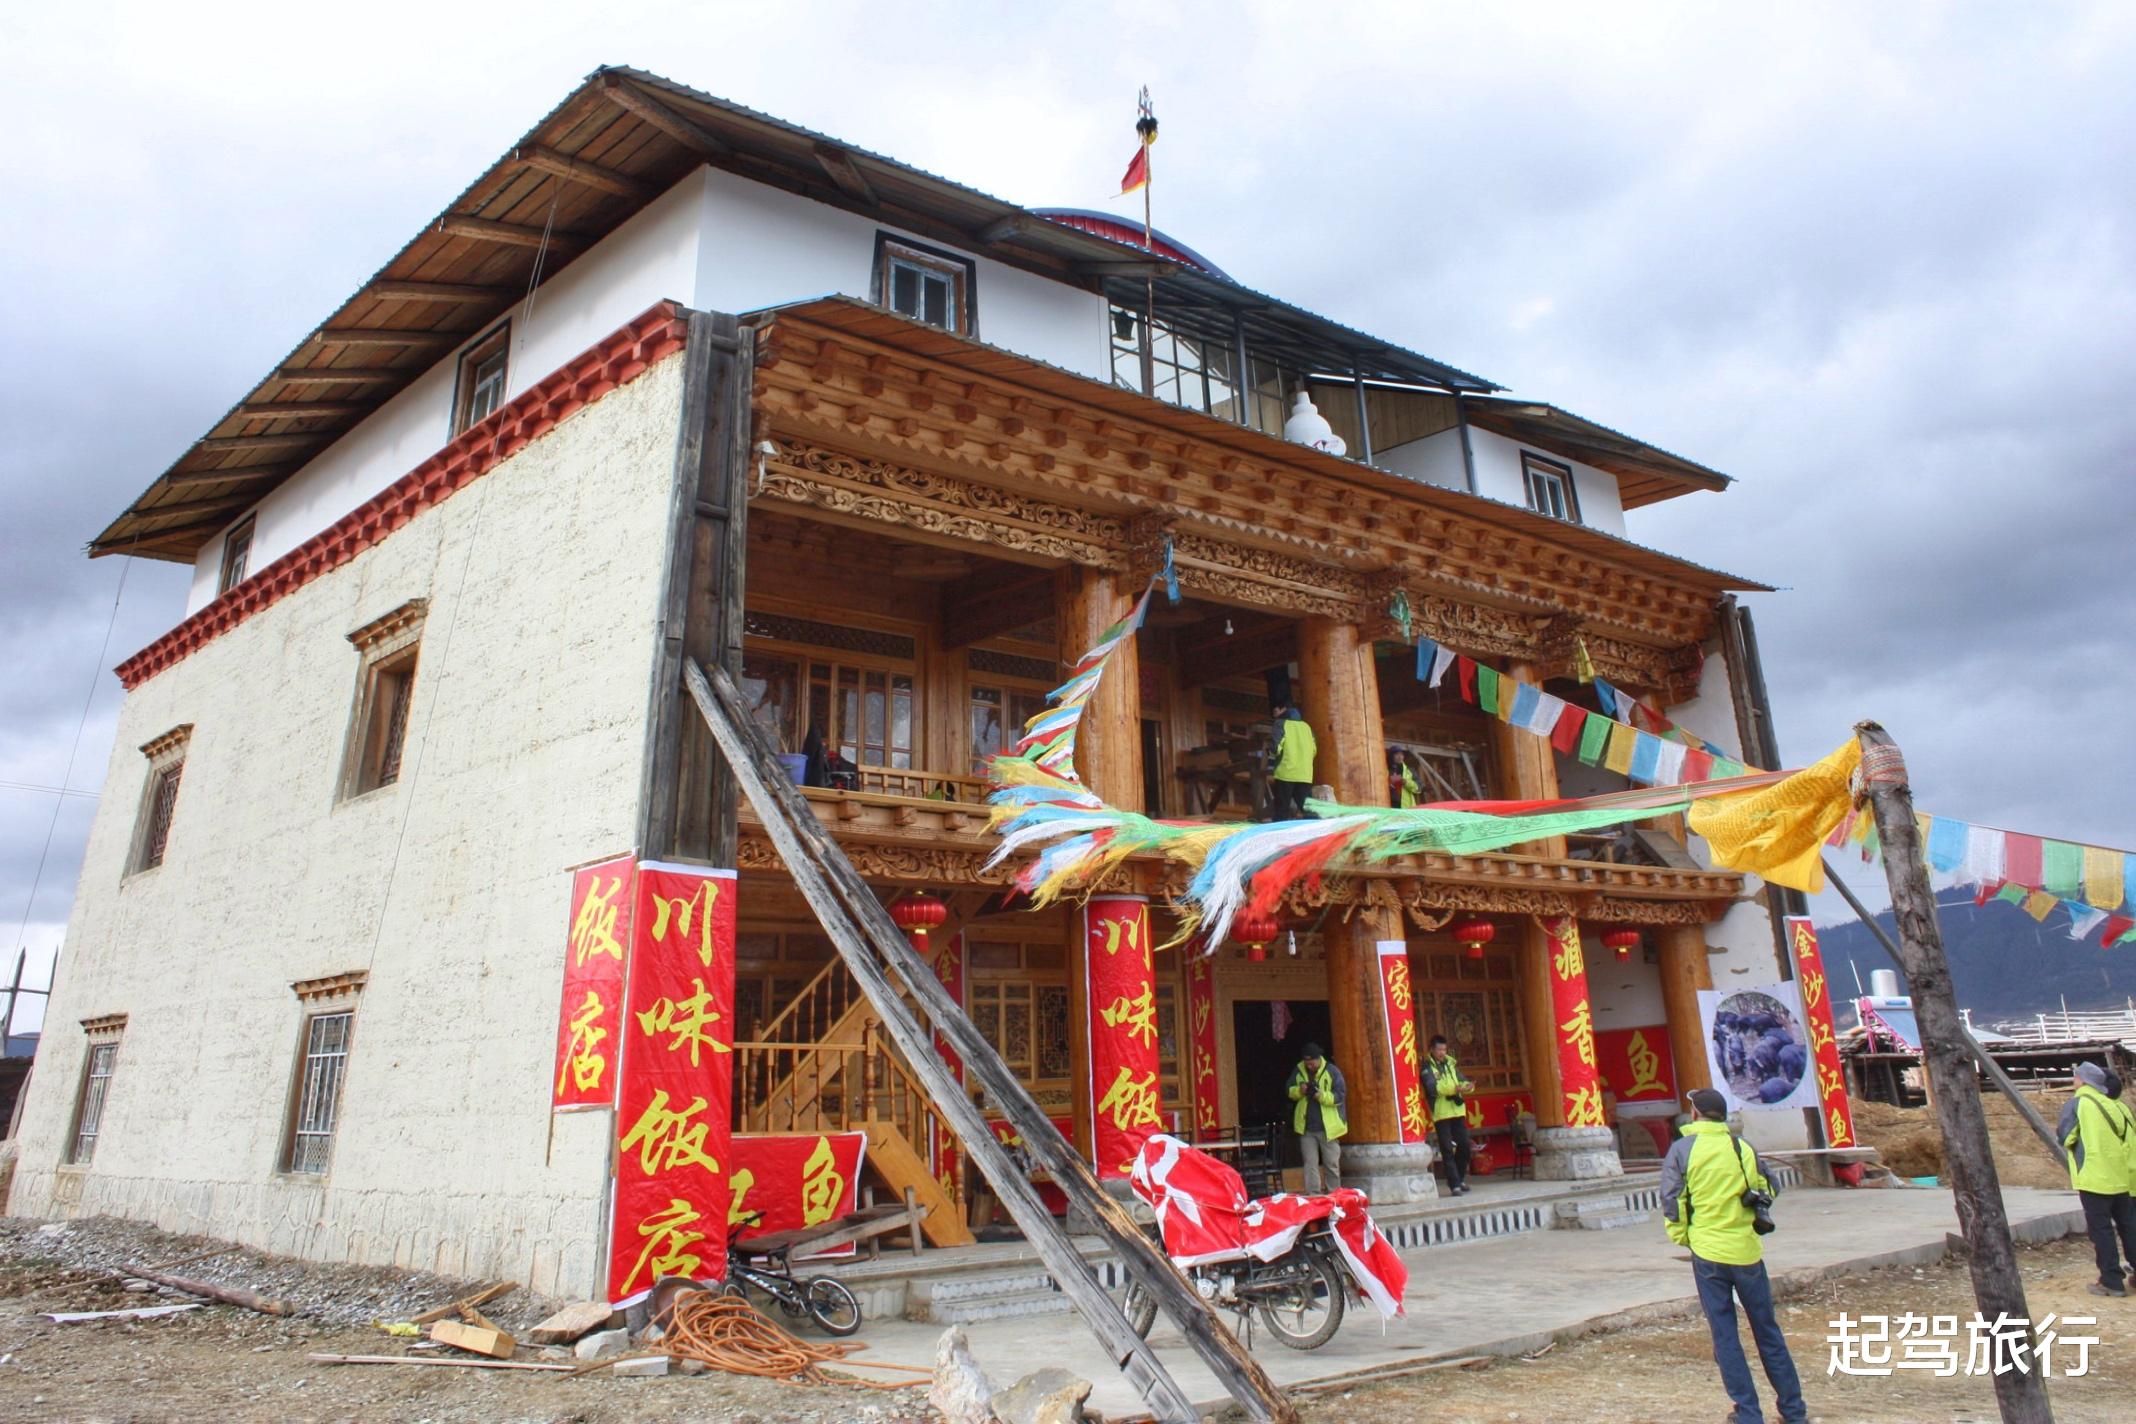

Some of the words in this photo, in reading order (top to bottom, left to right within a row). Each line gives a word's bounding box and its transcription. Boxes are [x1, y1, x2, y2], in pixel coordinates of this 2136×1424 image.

[558, 877, 624, 1097] 饭店
[620, 879, 732, 1293] 川味饭店
[1098, 904, 1163, 1172] 川味饭
[1388, 960, 1426, 1136] 家常菜
[1794, 923, 1852, 1148] 金沙江江鱼
